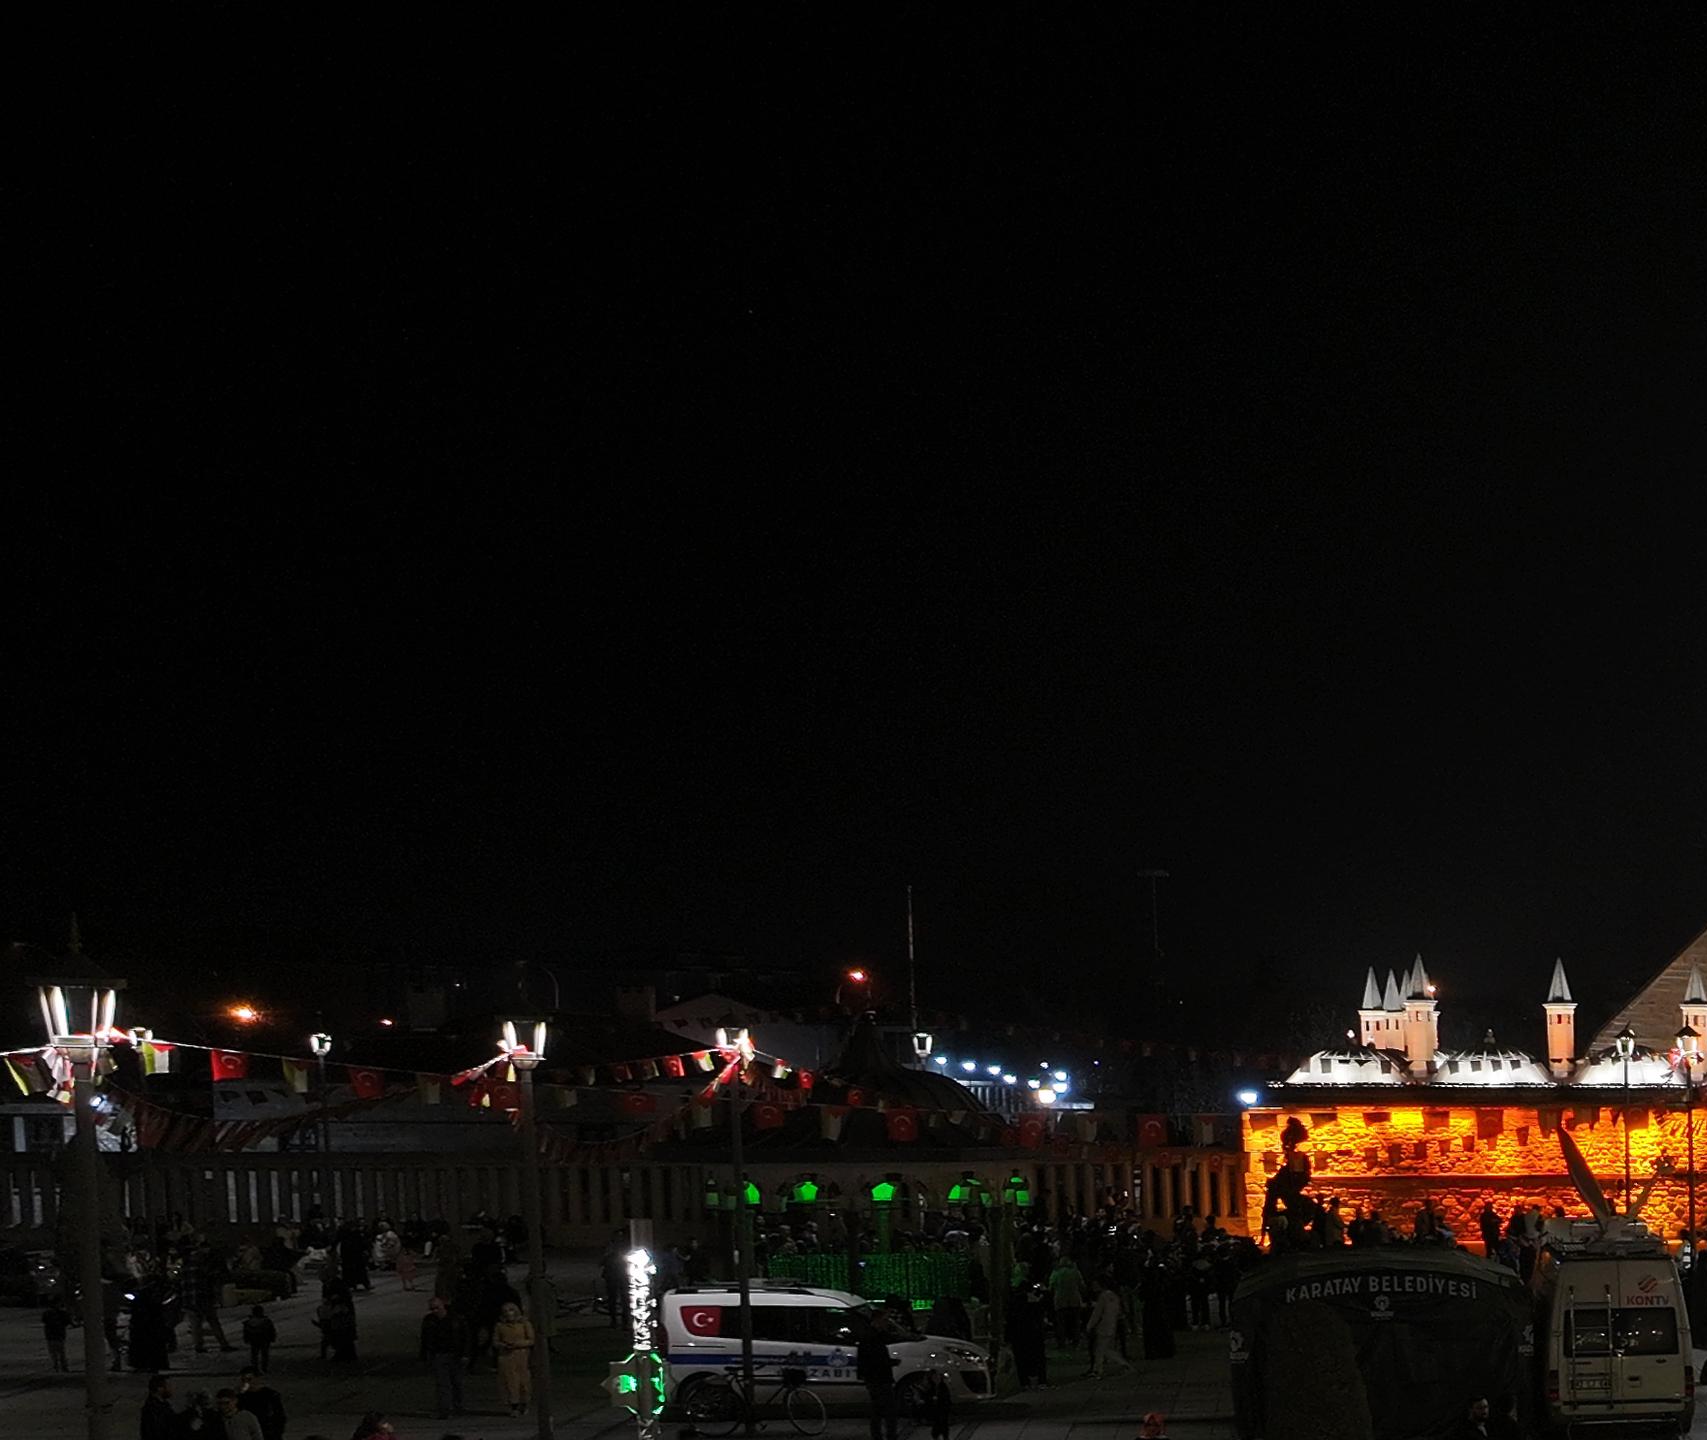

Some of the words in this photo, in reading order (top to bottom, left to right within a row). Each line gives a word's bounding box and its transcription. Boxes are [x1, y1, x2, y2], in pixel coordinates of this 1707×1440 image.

[1284, 1276, 1361, 1304] KARATAY
[1368, 1274, 1478, 1301] BELEDİYESİ
[1626, 1295, 1670, 1306] KONTV
